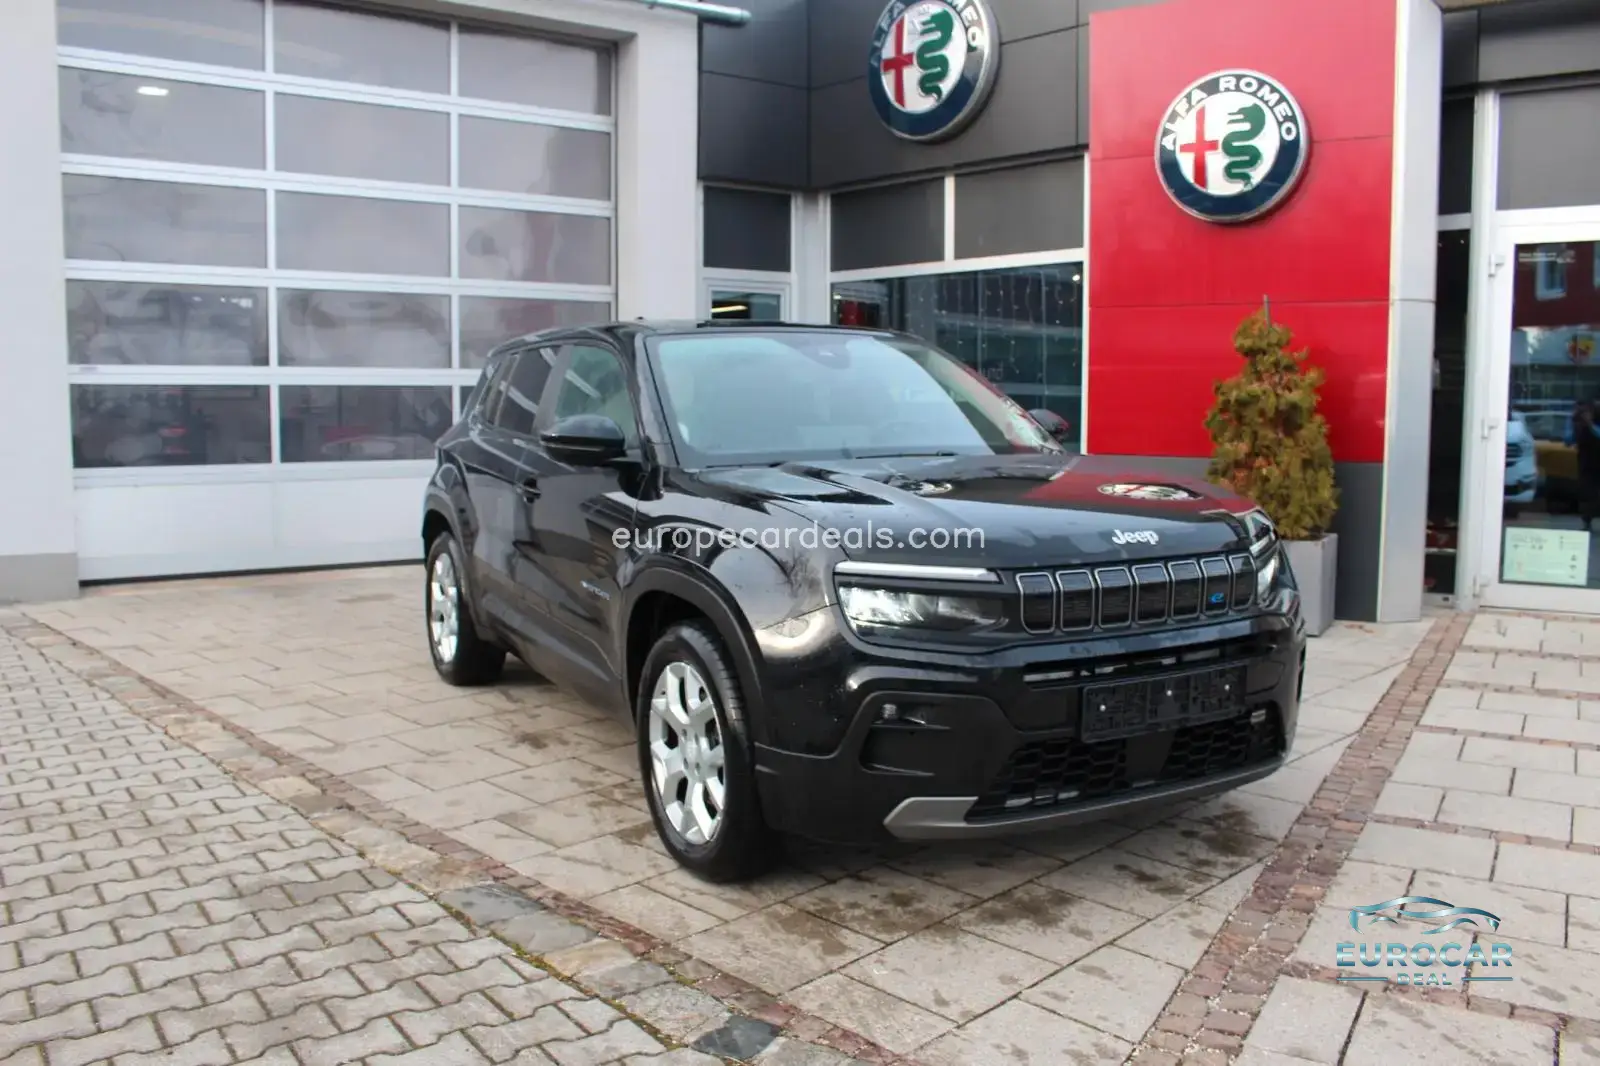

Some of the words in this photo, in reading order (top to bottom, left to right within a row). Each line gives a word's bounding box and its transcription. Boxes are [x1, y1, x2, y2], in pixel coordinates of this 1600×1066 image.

[1161, 88, 1208, 150] ALFA
[1218, 75, 1297, 141] ROMEO
[1111, 529, 1159, 545] Jeep
